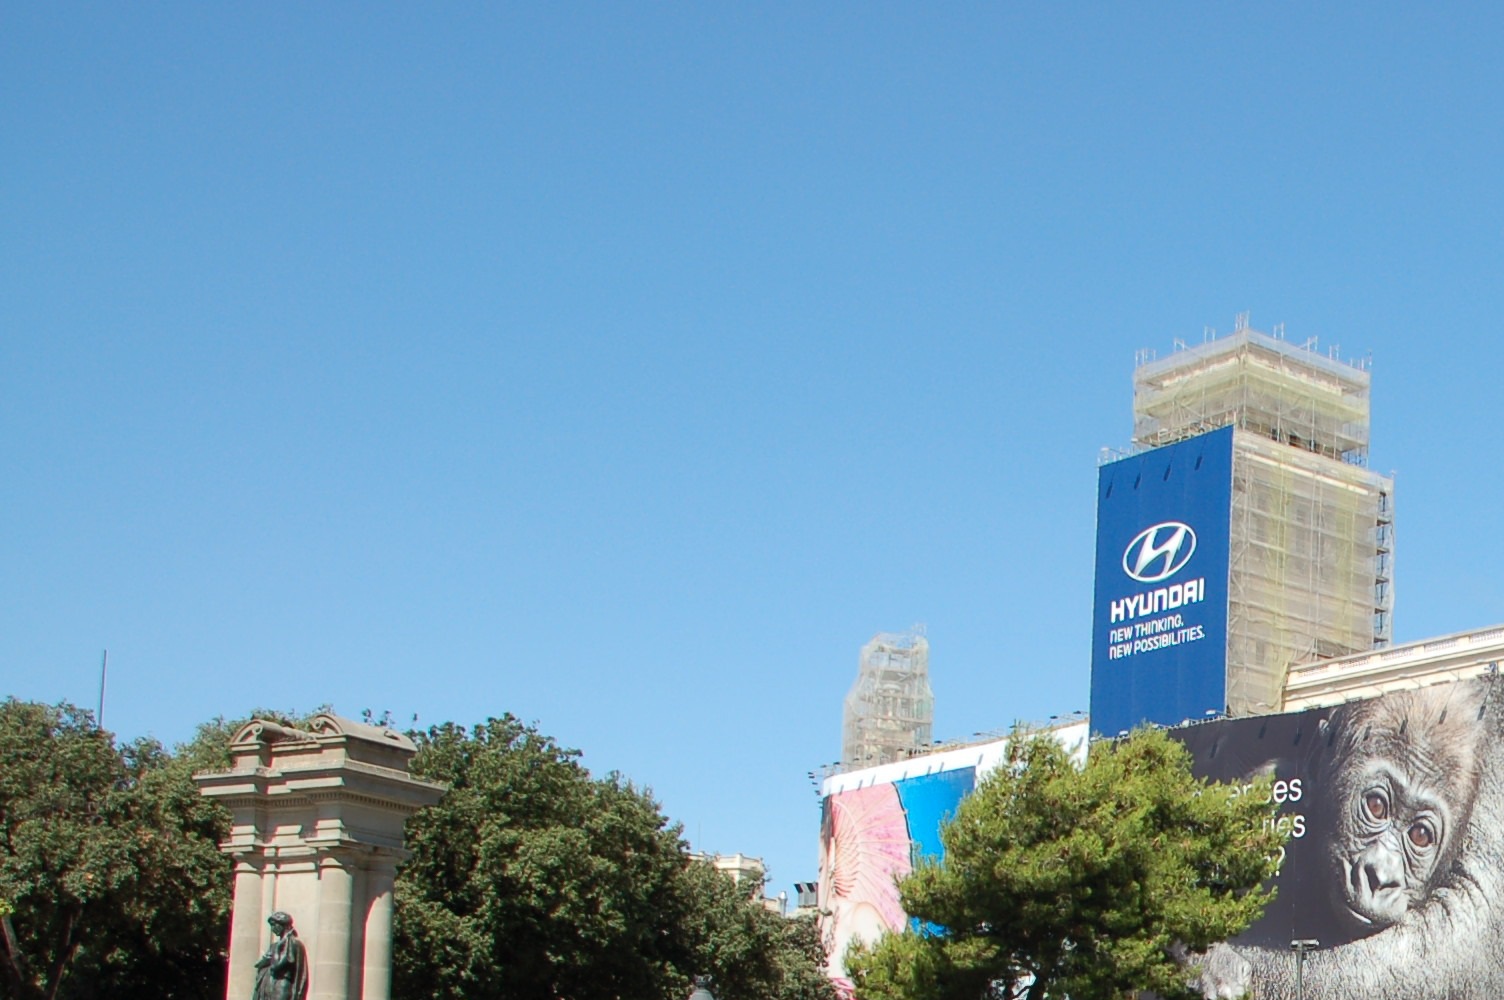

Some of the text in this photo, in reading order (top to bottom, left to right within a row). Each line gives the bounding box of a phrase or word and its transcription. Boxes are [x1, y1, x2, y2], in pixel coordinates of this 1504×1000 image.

[1110, 577, 1205, 624] HYUNDAI
[1108, 625, 1205, 660] NEW POSSIBILITIES.
[1109, 613, 1184, 645] NEW THINKING.
